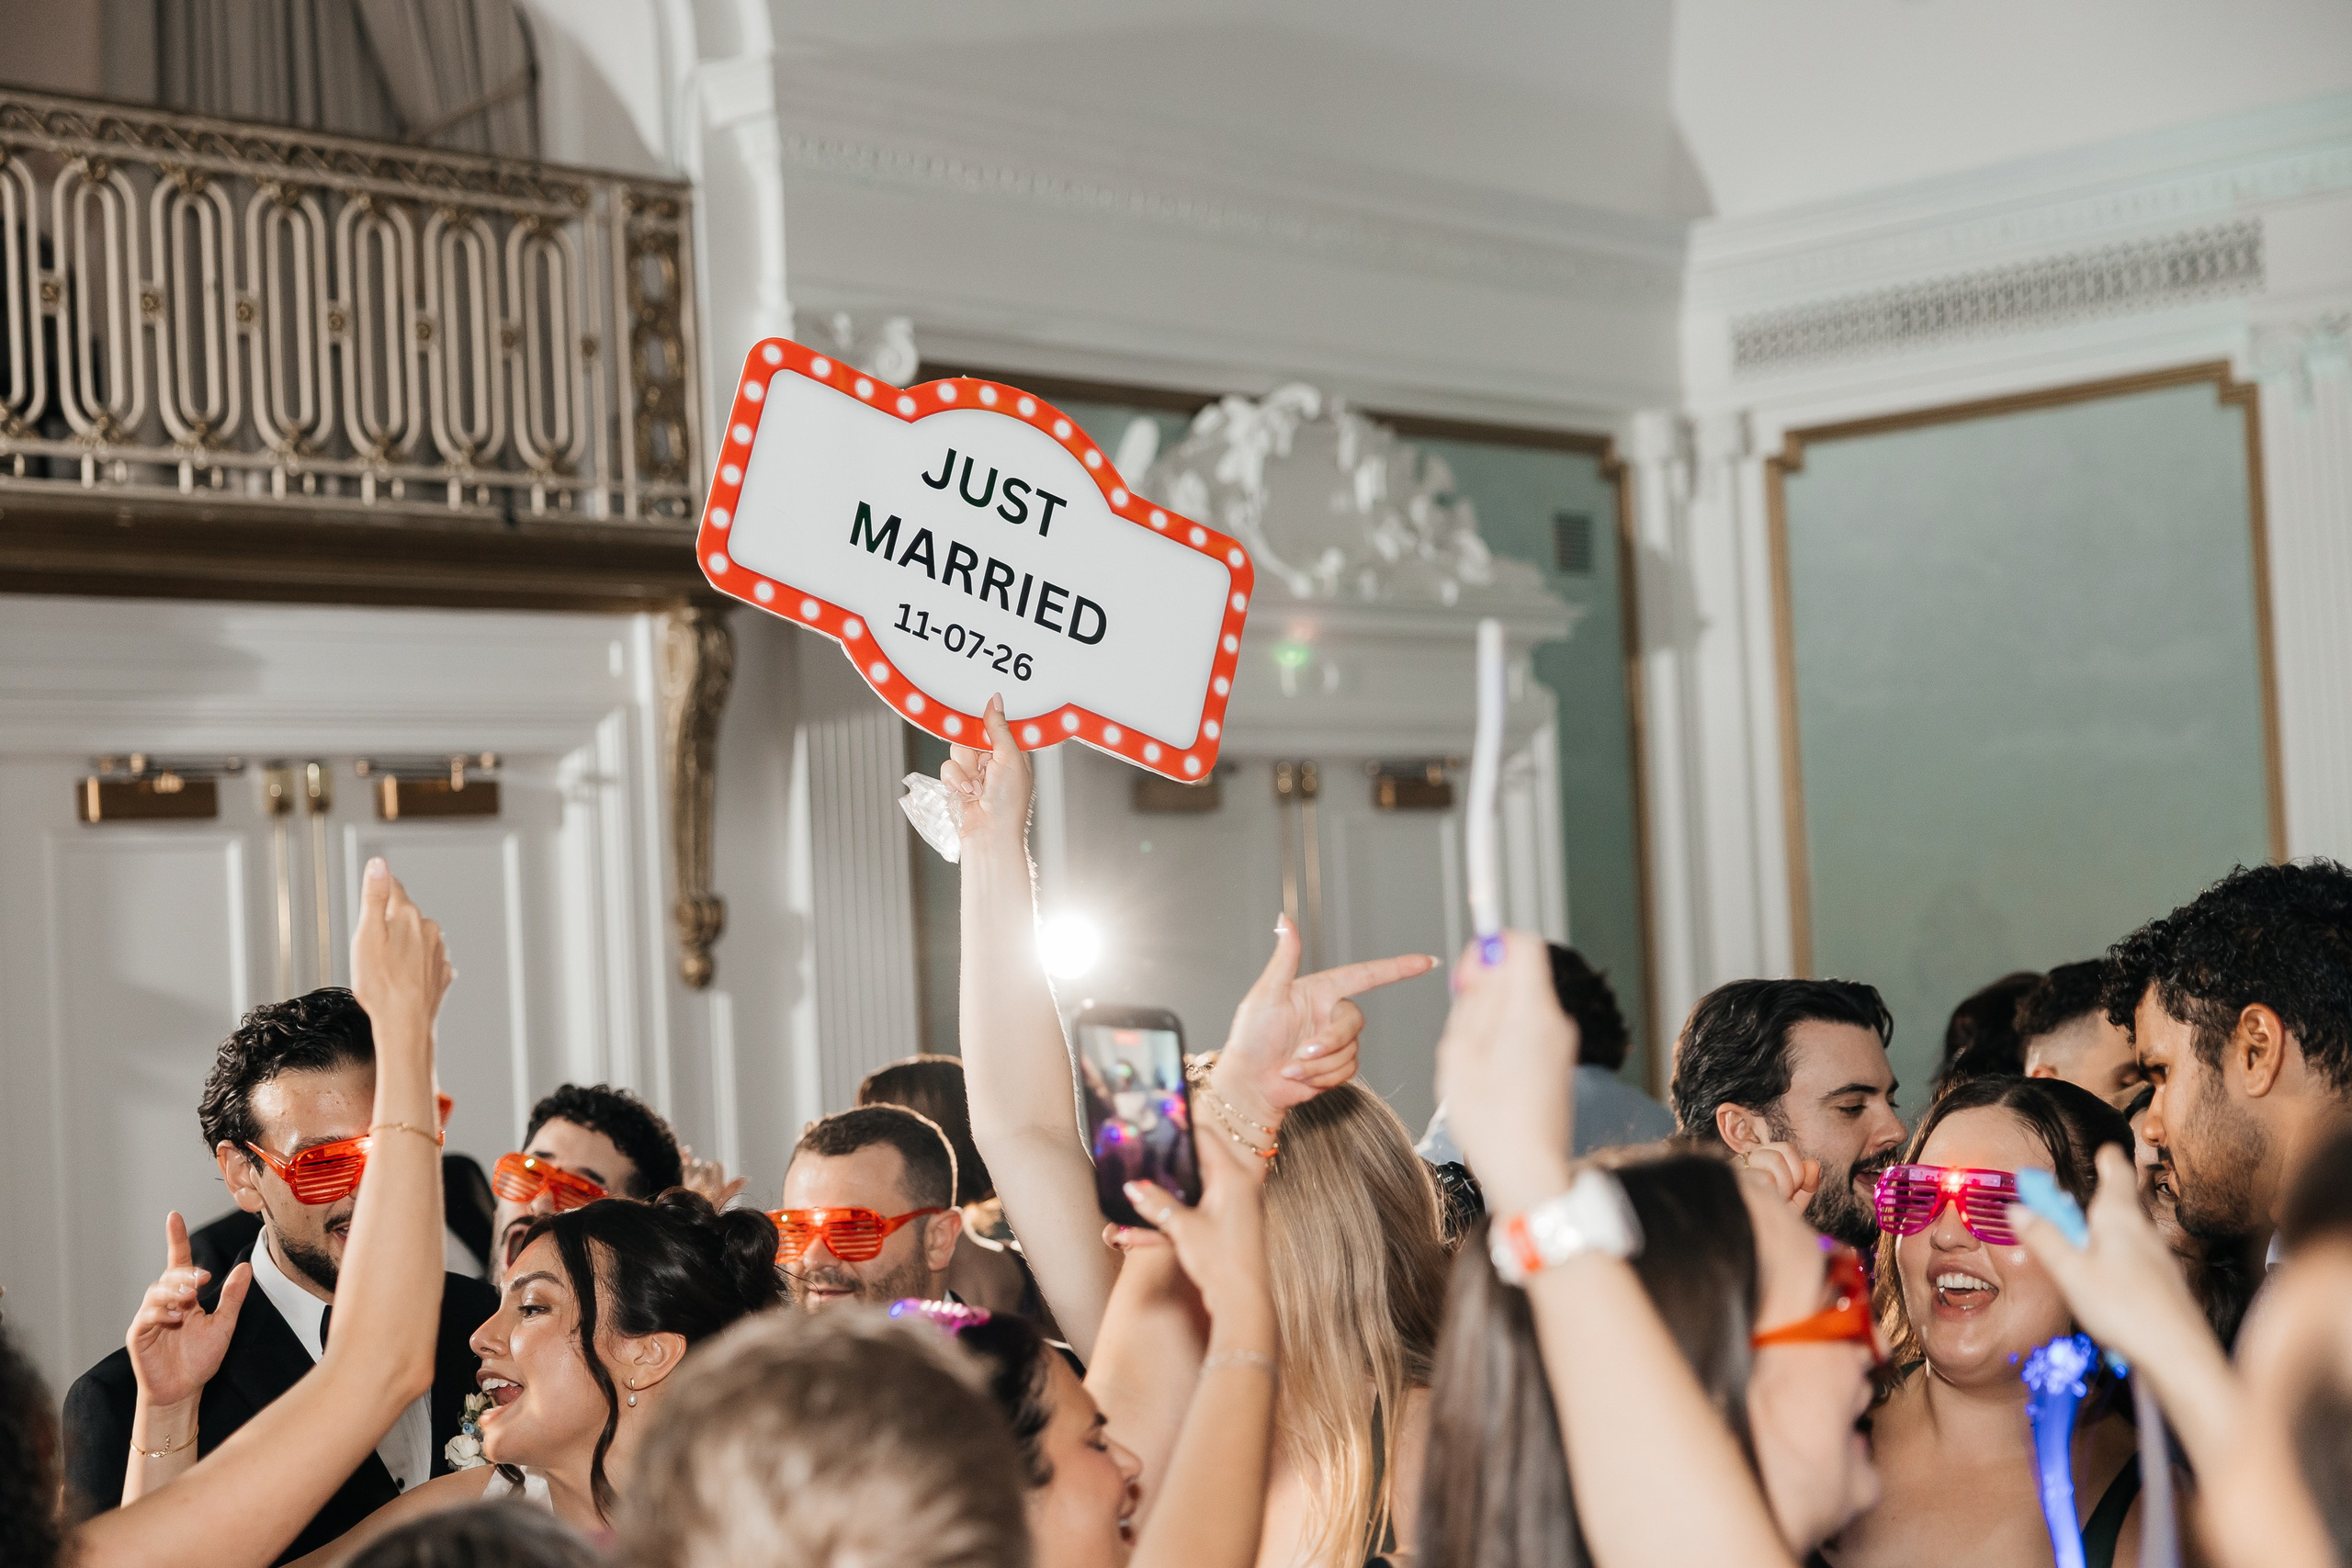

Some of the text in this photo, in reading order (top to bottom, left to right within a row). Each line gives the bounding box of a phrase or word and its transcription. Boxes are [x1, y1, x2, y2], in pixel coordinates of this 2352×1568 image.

[921, 447, 1068, 538] JUST
[849, 500, 1108, 646] MARRIED
[893, 603, 1034, 682] 11-07-26
